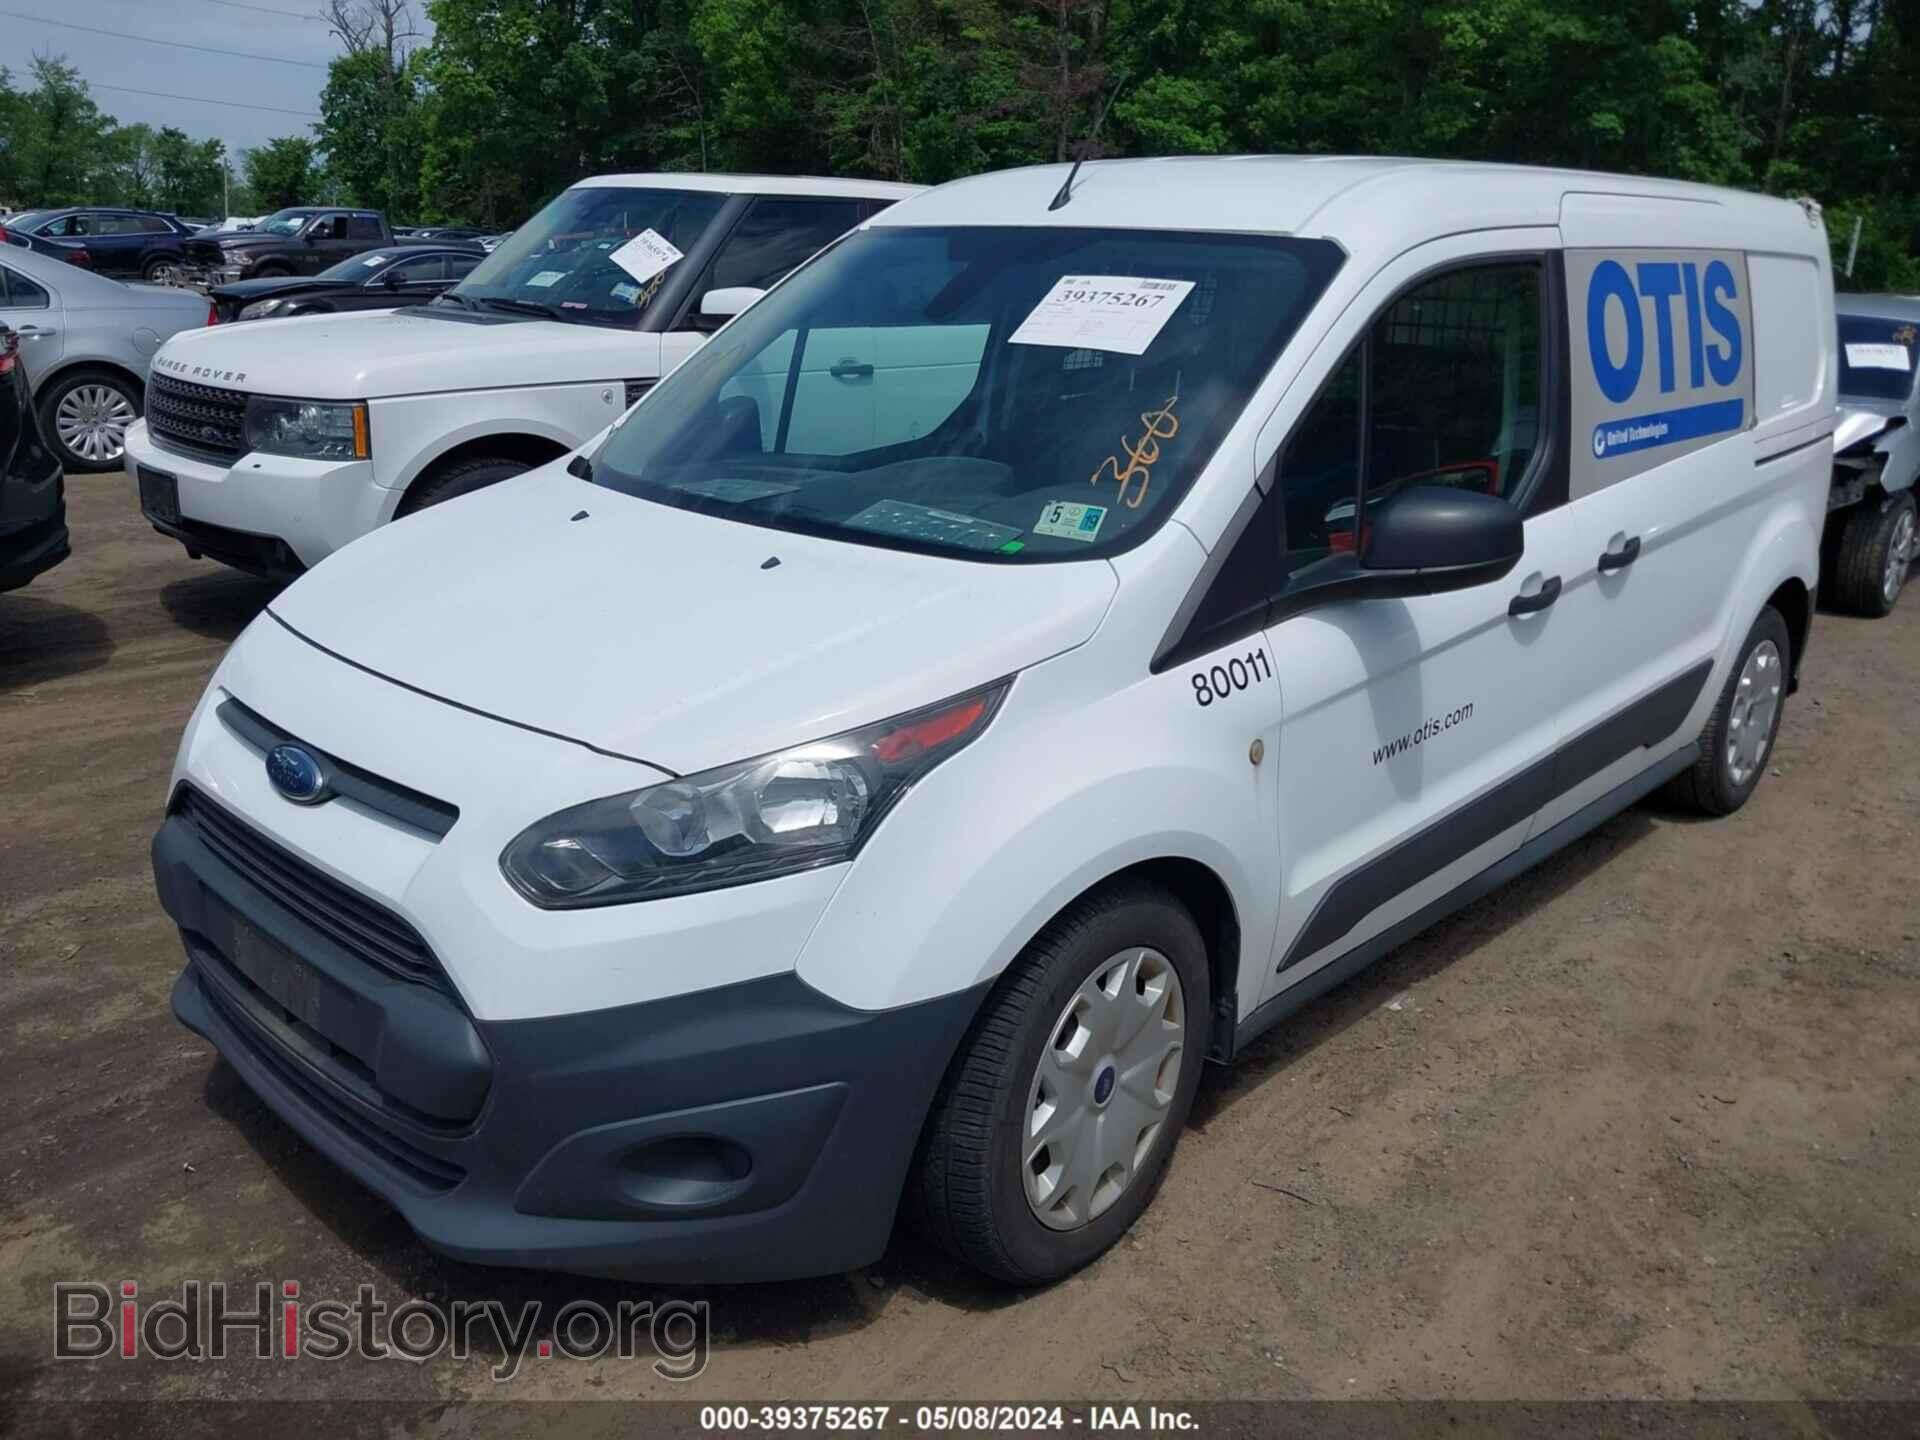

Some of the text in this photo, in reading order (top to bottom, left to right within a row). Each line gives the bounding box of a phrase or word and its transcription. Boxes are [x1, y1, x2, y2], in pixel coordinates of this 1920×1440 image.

[1056, 289, 1165, 309] 39375267
[1587, 259, 1742, 404] OTIS
[192, 367, 247, 382] ROVER
[1050, 505, 1063, 523] 5
[1191, 648, 1272, 707] 80011
[1372, 702, 1474, 766] www.otis.com
